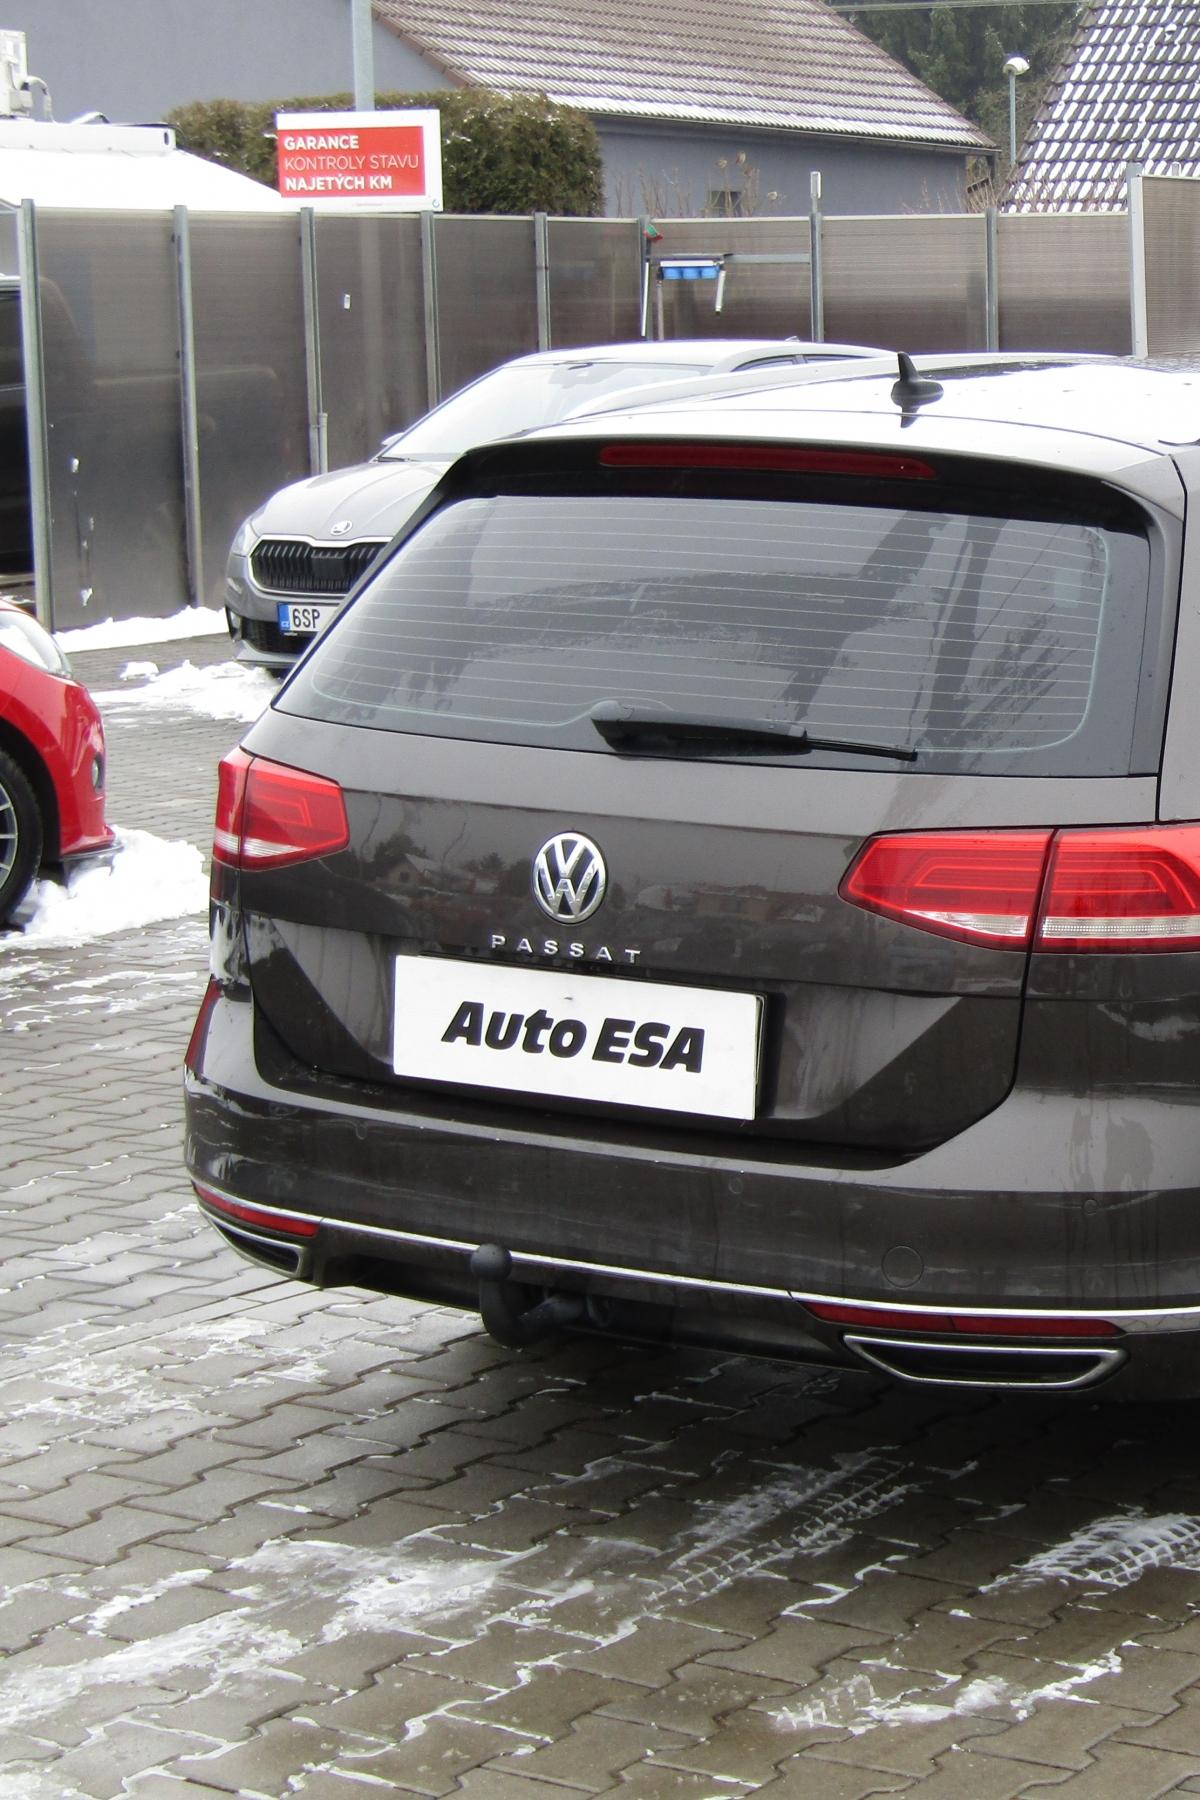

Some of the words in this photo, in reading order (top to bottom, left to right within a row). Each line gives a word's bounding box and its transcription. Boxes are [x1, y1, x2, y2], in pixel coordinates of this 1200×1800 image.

[284, 135, 359, 150] GARANCE
[284, 155, 365, 171] KONTROLY
[370, 154, 419, 169] STAVU
[285, 173, 365, 191] NAJETÝCH
[369, 175, 392, 189] KM
[292, 608, 321, 629] 6SP
[490, 934, 642, 964] PASSAT
[441, 1000, 588, 1059] Auto
[591, 1017, 706, 1074] ESA
